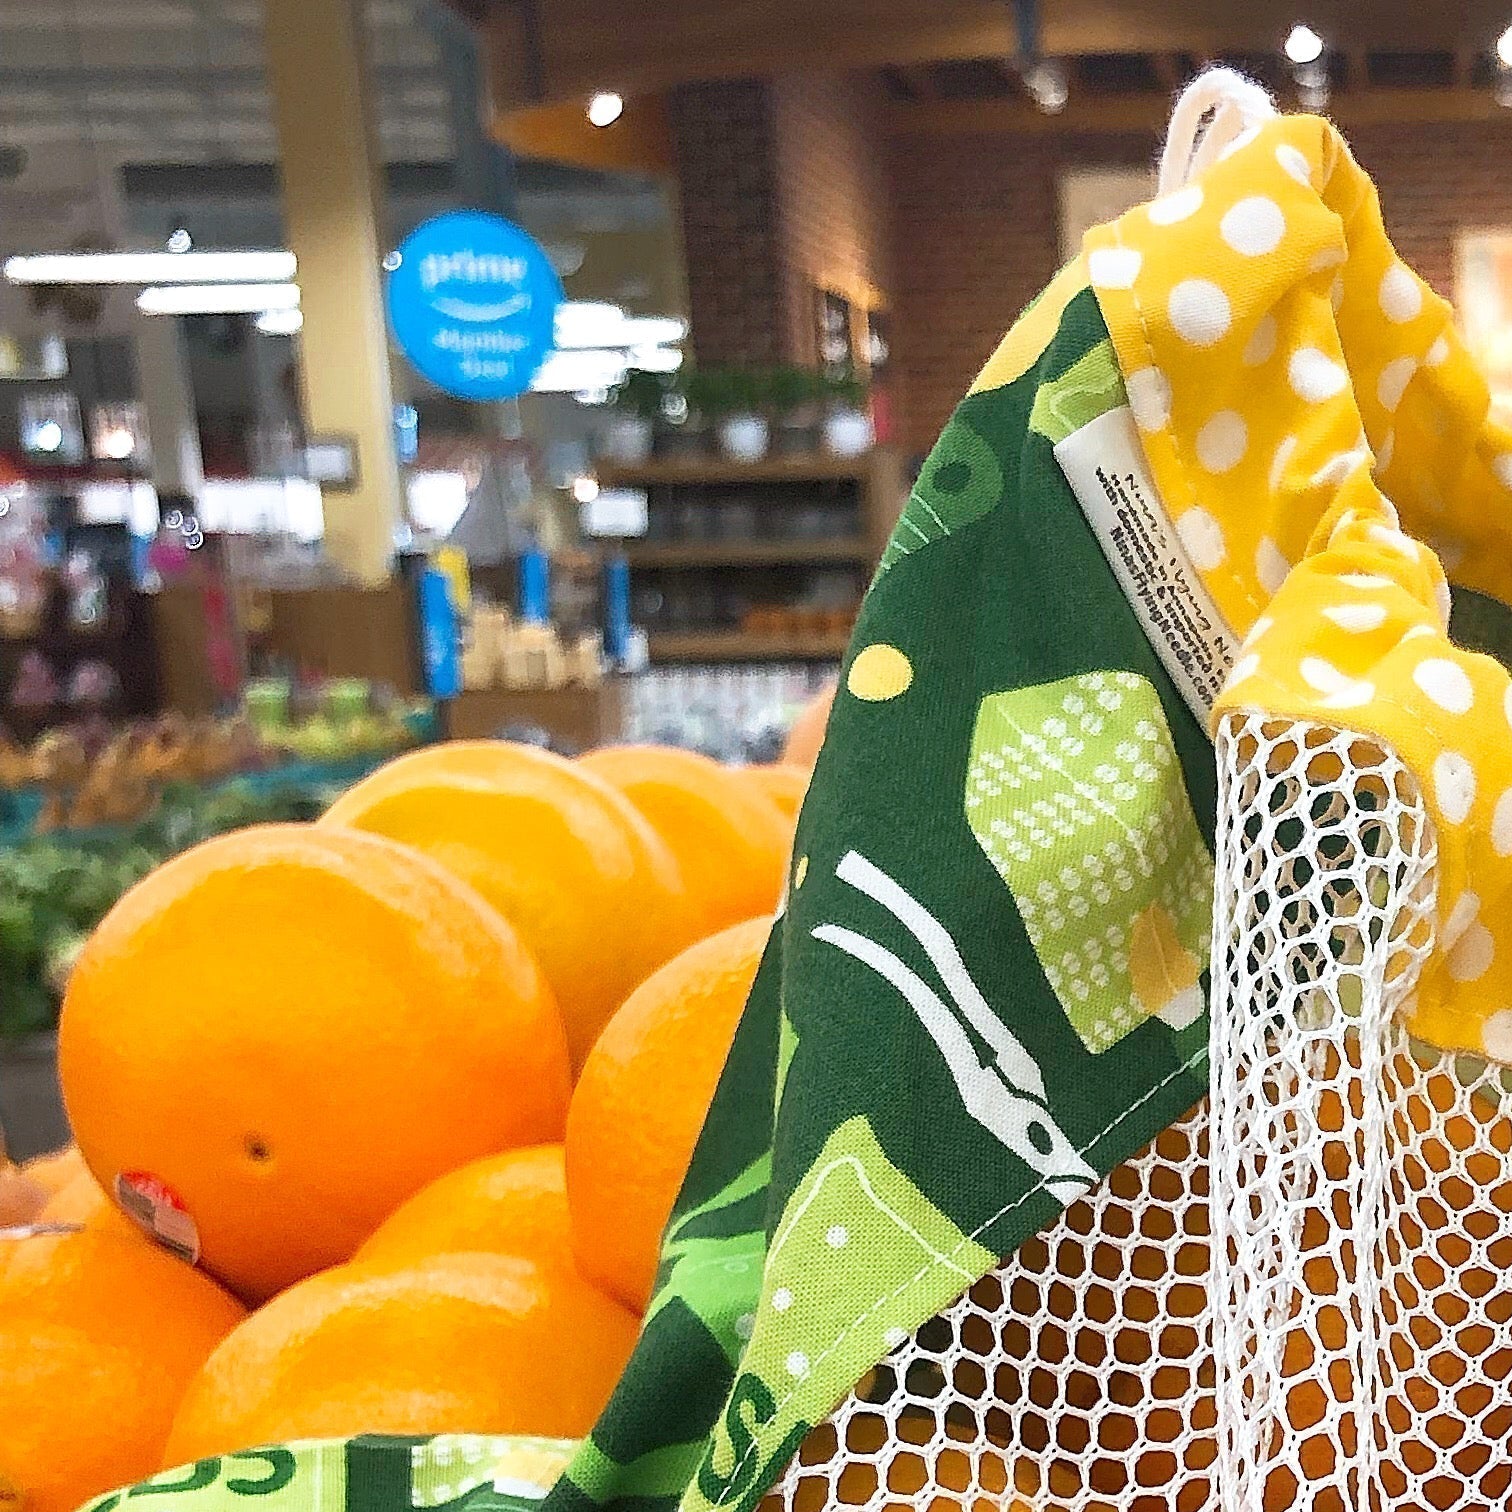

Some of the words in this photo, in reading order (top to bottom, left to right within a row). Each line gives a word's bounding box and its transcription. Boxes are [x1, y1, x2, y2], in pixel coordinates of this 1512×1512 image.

[1095, 465, 1119, 507] with
[1116, 506, 1159, 584] domestic
[1163, 601, 1214, 676] imported
